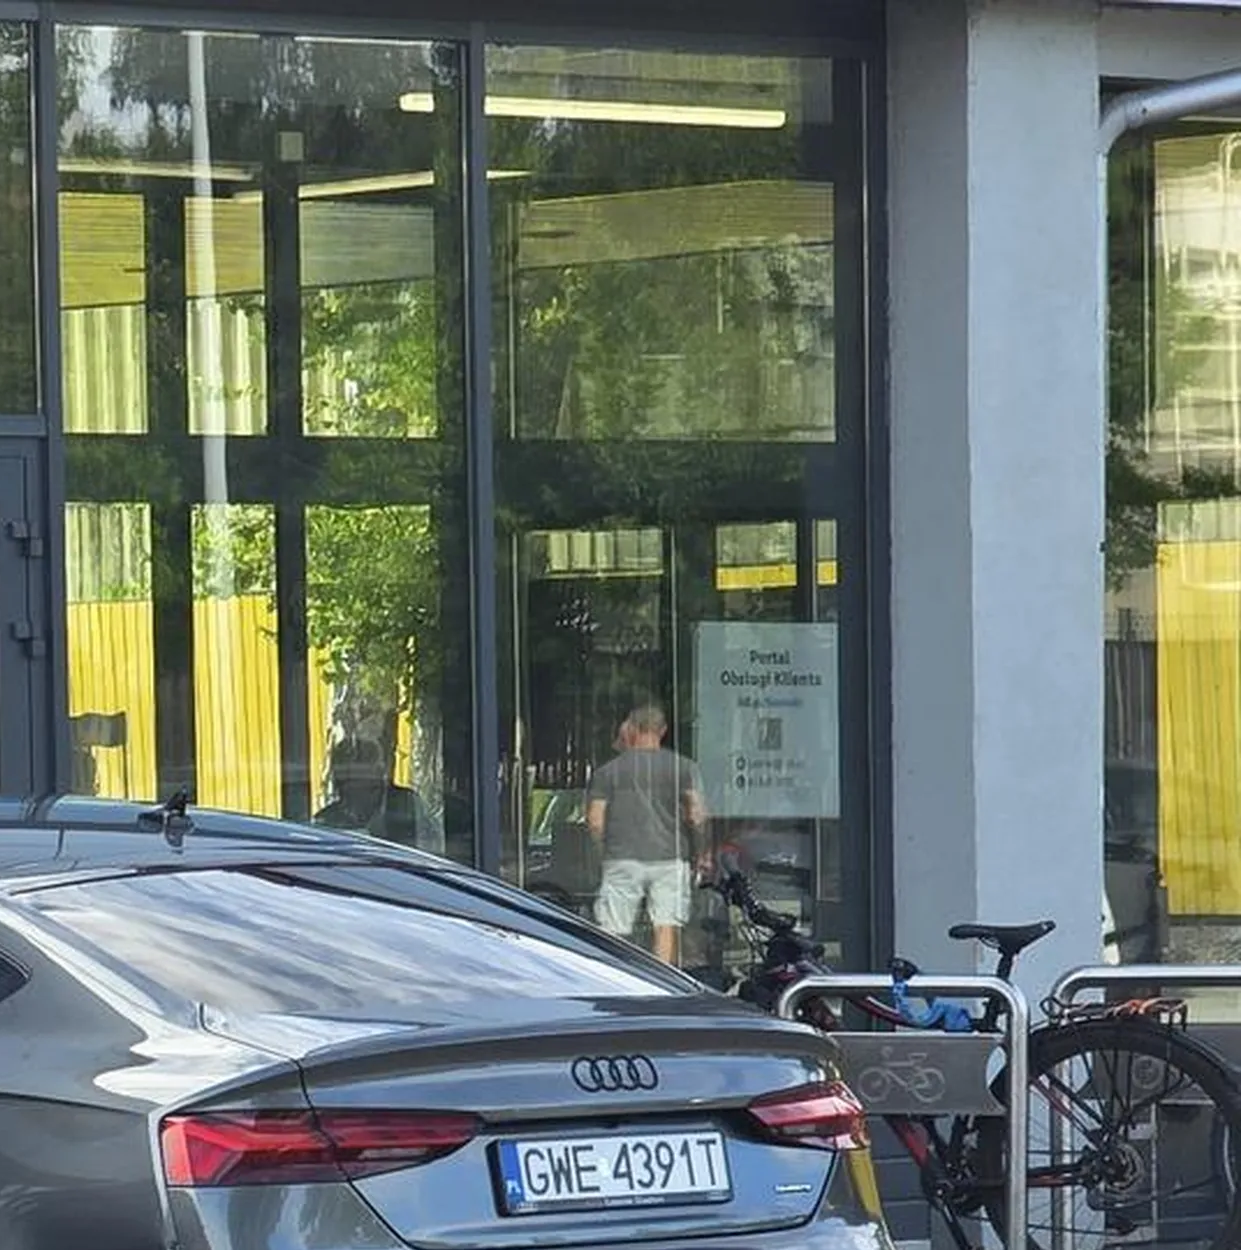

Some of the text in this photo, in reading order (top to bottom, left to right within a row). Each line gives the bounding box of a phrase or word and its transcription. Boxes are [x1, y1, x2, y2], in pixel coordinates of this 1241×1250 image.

[749, 649, 791, 665] Portal
[774, 670, 823, 687] Klienta
[523, 1138, 717, 1195] GWE 4391T
